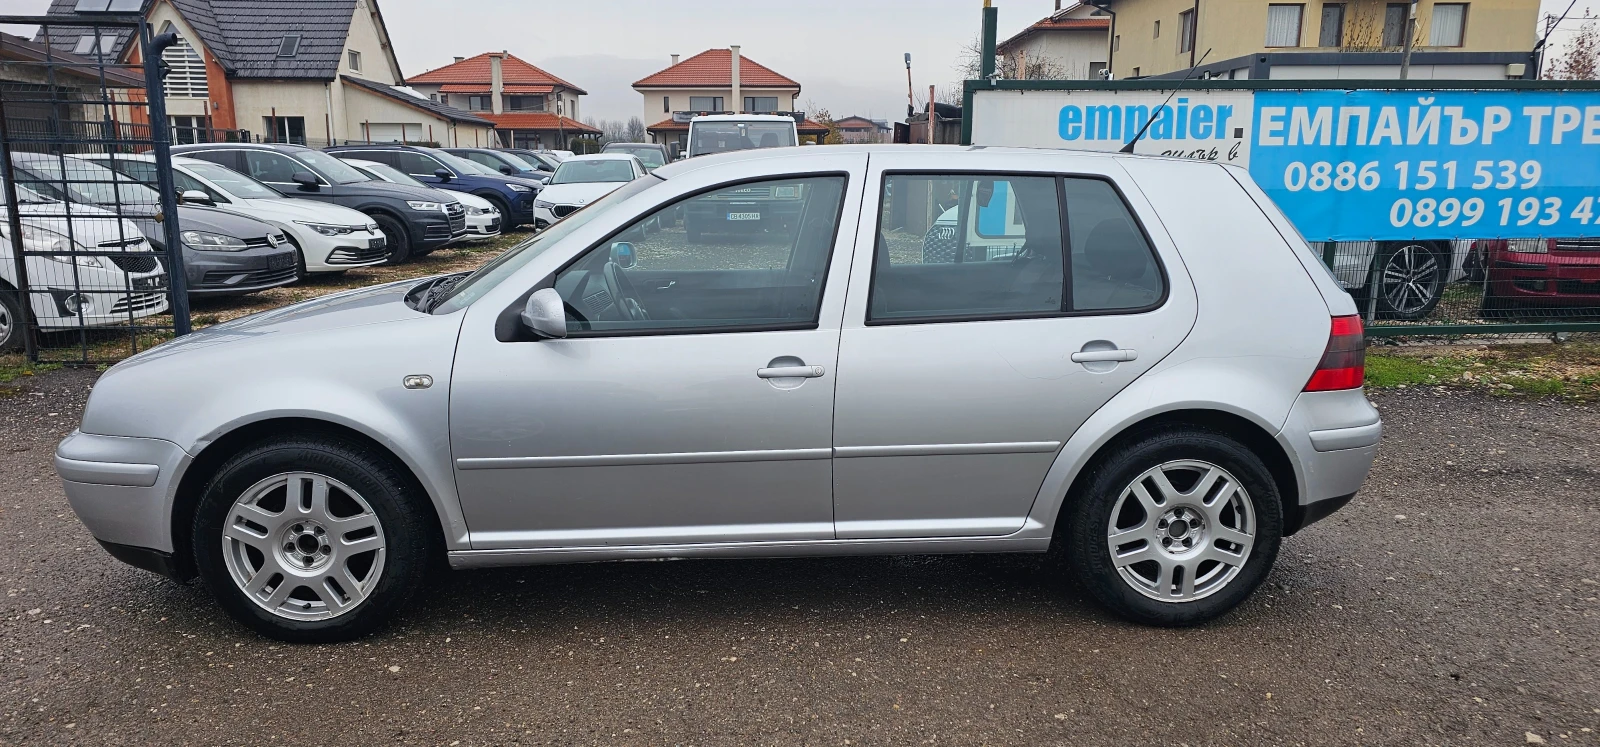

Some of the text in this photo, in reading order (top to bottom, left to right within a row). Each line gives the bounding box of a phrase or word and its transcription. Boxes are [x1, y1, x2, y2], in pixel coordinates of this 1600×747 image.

[1258, 96, 1512, 147] ЕМПАЙЪР
[1284, 159, 1542, 192] 0886 151 539
[1389, 197, 1485, 228] 0899
[1498, 196, 1563, 226] 193
